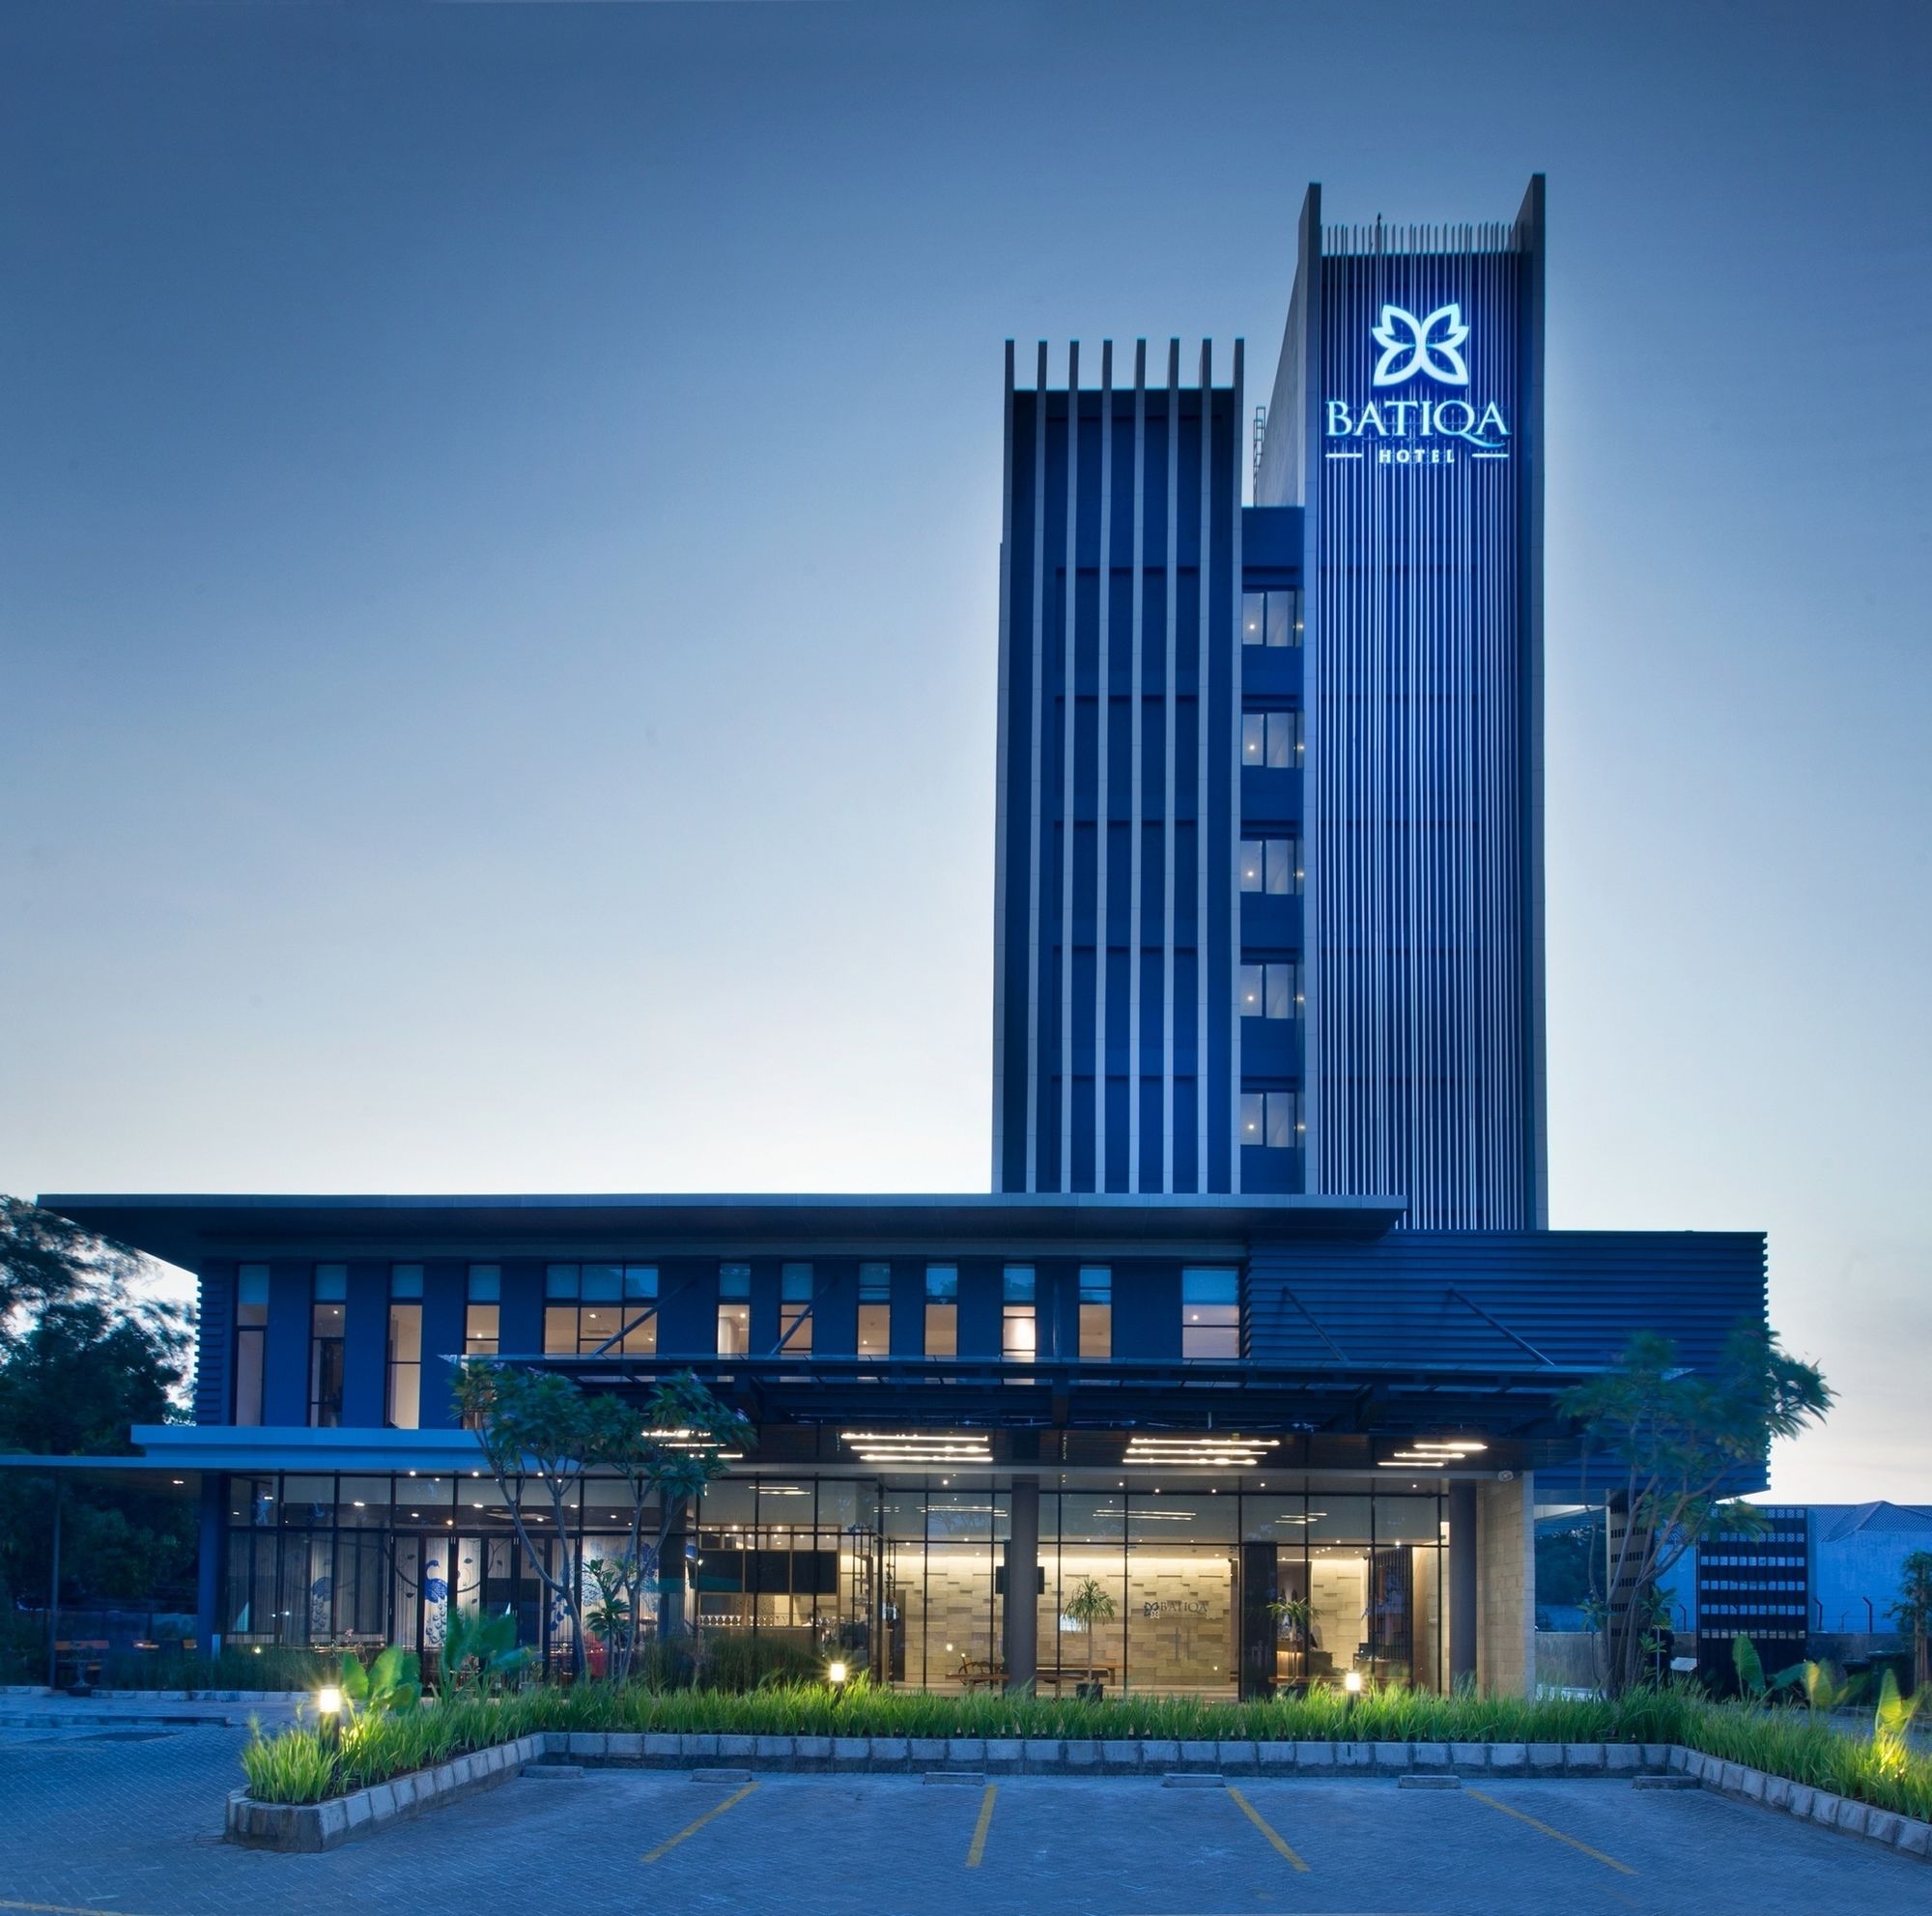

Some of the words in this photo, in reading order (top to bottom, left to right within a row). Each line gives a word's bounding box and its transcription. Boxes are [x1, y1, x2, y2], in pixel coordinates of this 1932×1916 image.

[1325, 400, 1512, 447] BATIQA
[1378, 449, 1455, 464] HOTEL
[1160, 1601, 1208, 1614] BATIQA
